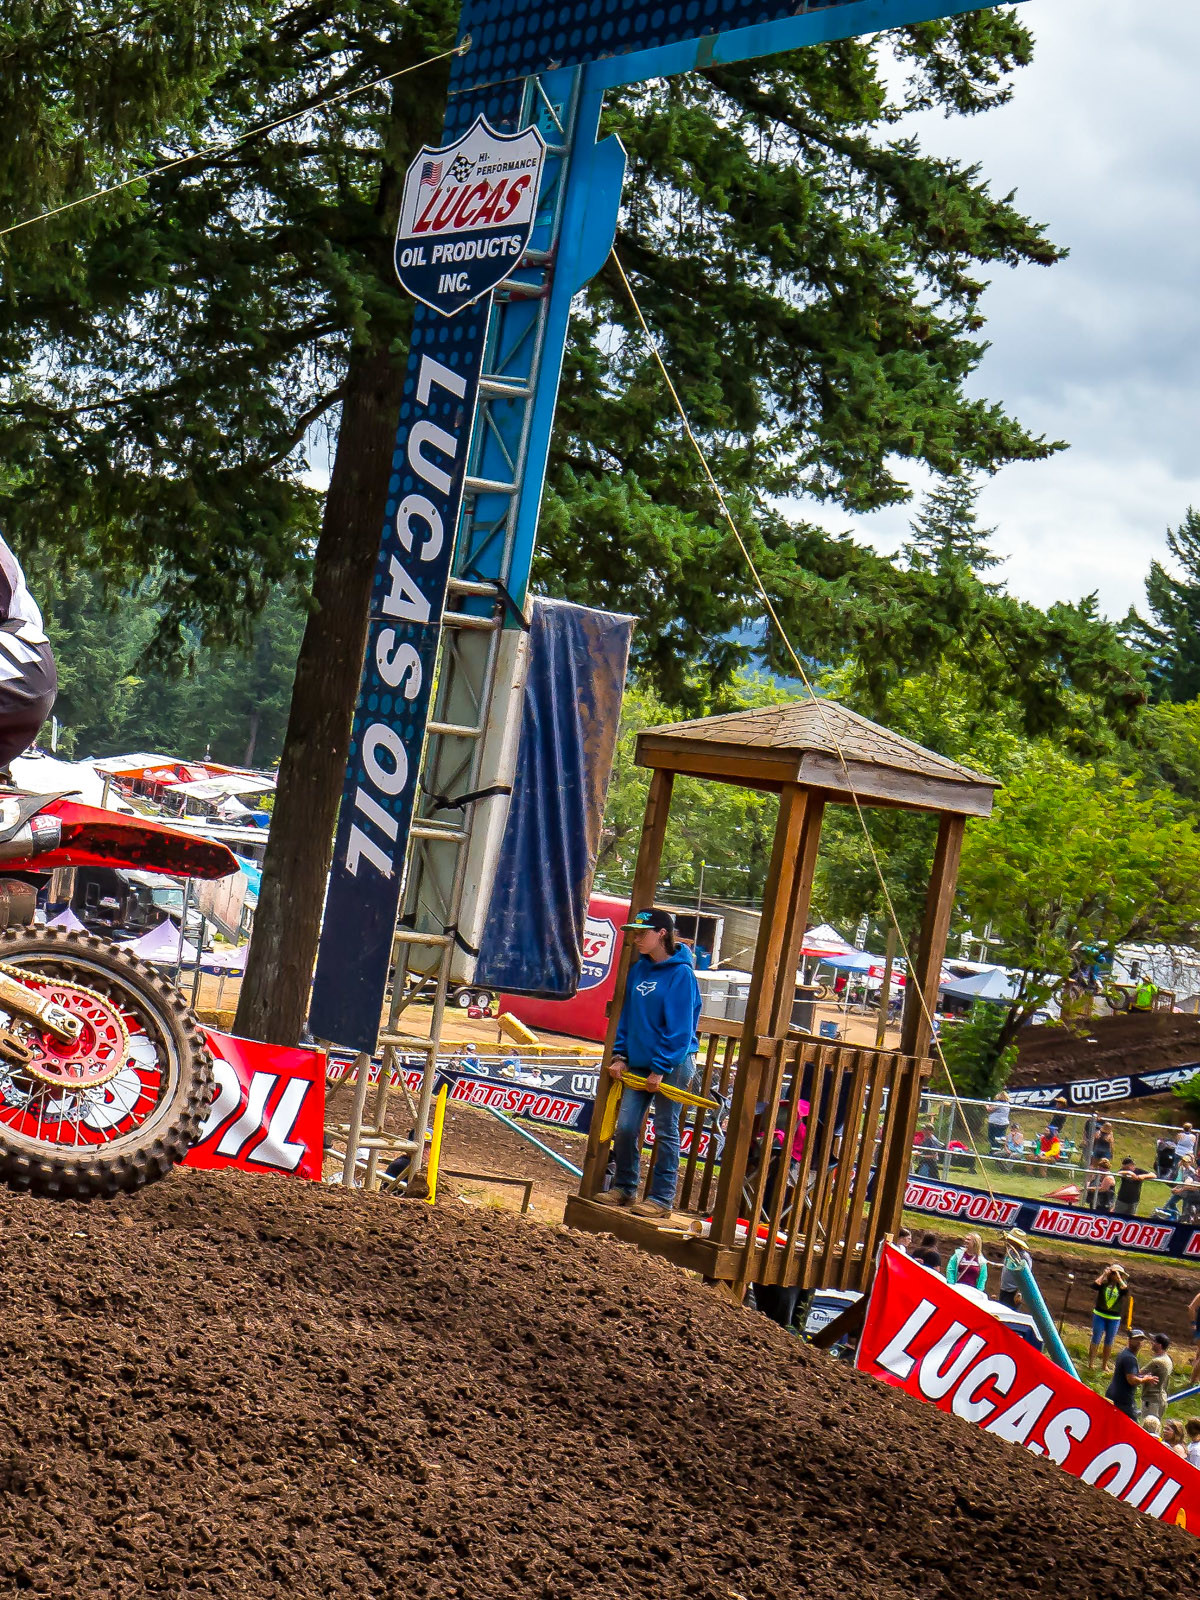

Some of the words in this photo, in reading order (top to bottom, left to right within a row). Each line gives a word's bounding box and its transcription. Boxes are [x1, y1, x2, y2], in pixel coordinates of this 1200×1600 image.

[476, 157, 537, 176] PERFORMANCE
[478, 152, 490, 163] HI-
[412, 174, 532, 233] LUCAS
[400, 246, 427, 268] OIL
[431, 234, 522, 265] PRODUCTS
[437, 271, 471, 294] INC.
[375, 353, 468, 701] LUCAS
[344, 721, 409, 880] OIL
[1071, 1077, 1132, 1105] WPS
